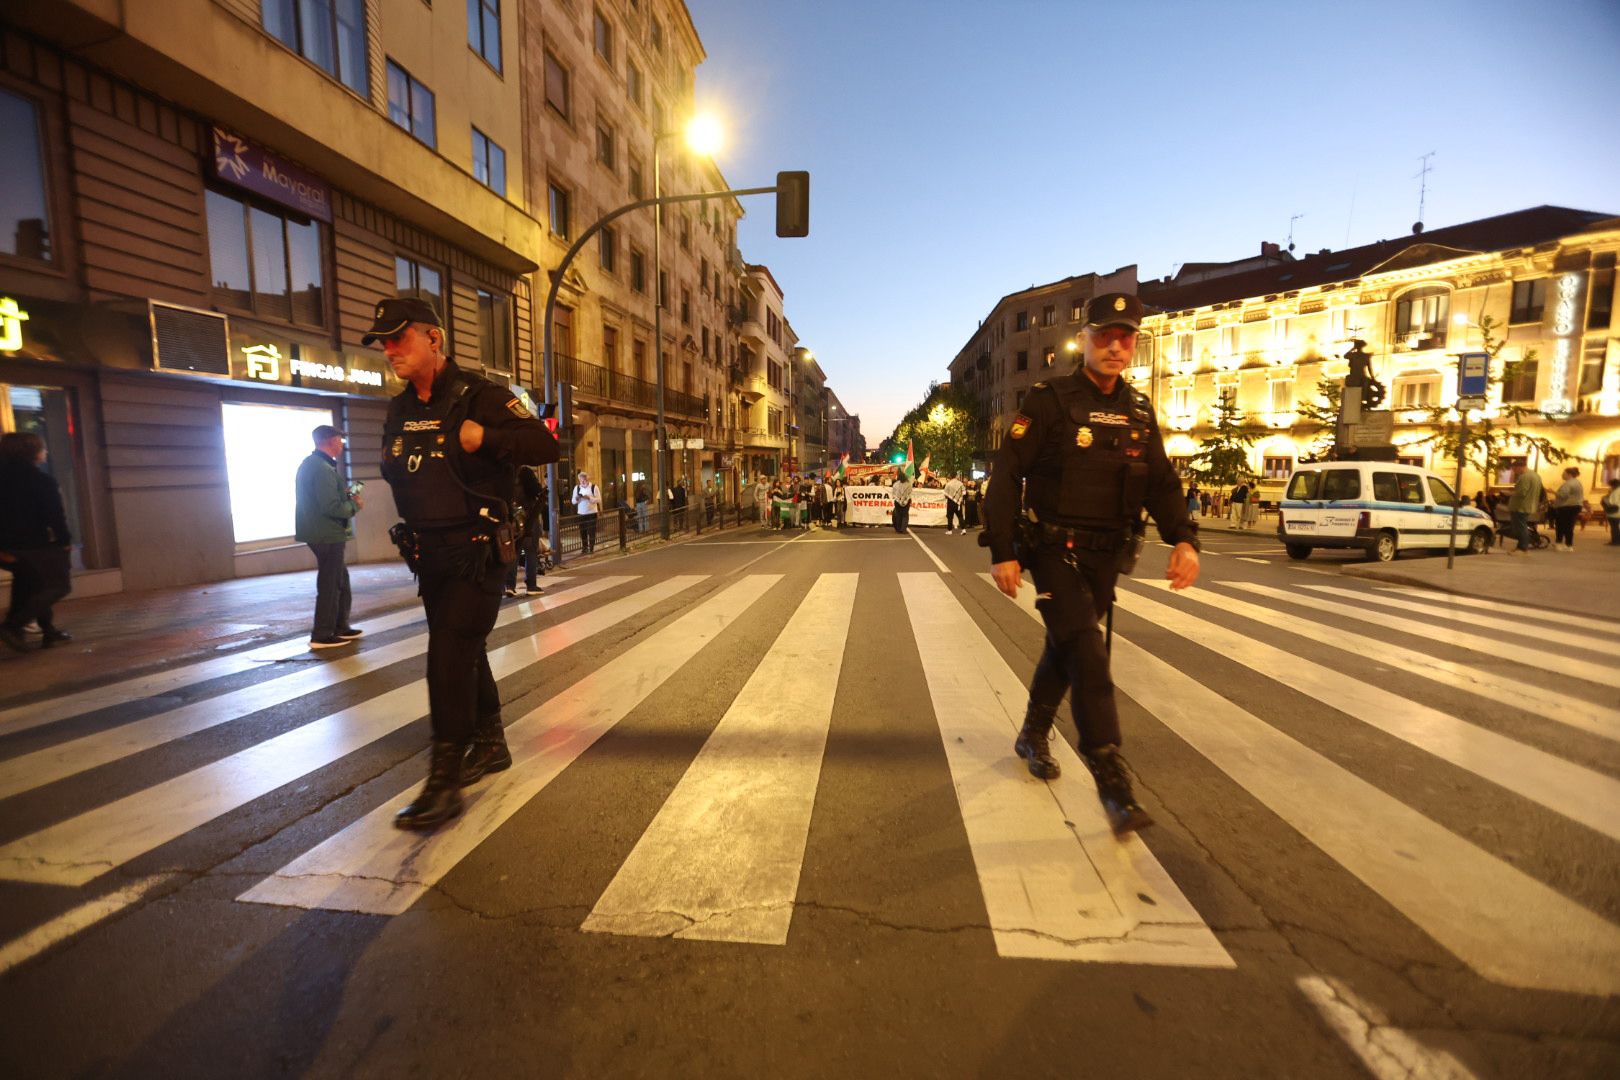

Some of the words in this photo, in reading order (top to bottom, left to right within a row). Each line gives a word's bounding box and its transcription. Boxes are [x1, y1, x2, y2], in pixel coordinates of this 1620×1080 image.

[262, 161, 326, 204] Mayoral
[289, 359, 345, 382] FINCAS
[347, 368, 382, 387] JUAN
[852, 492, 890, 500] CONTRA
